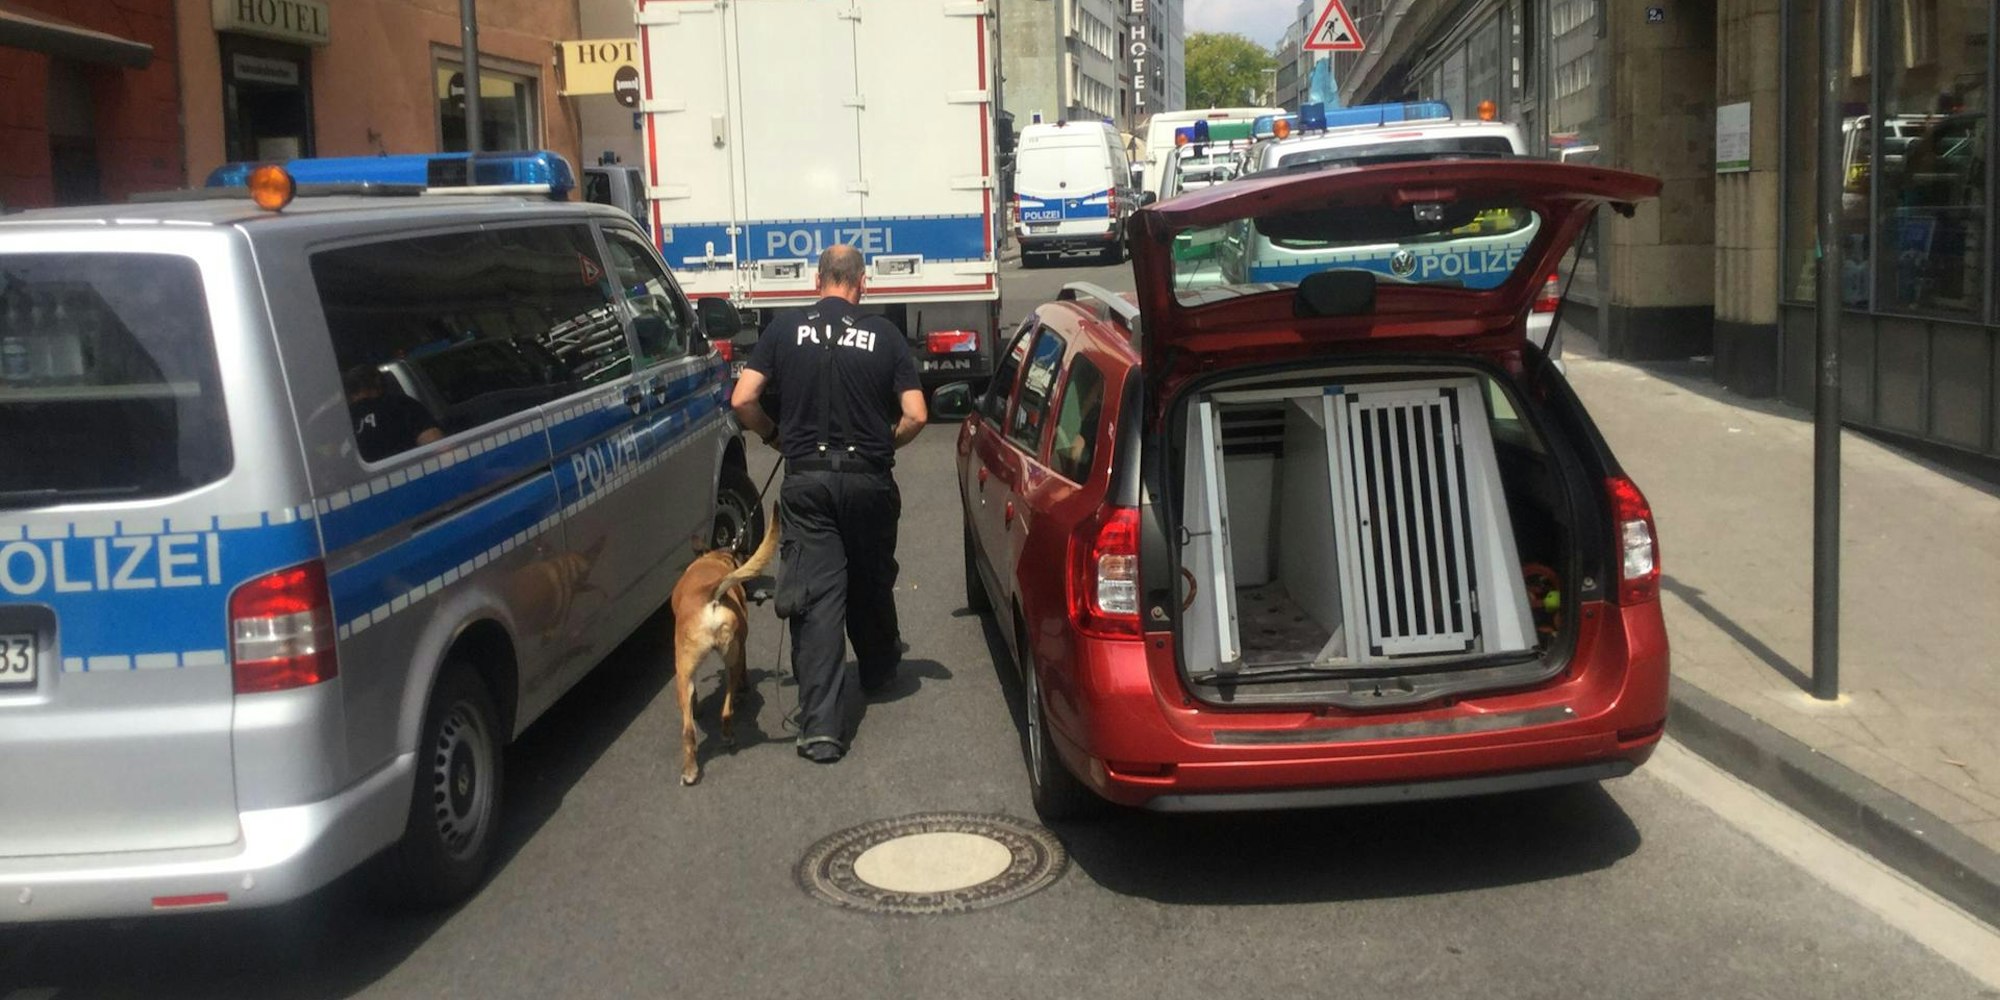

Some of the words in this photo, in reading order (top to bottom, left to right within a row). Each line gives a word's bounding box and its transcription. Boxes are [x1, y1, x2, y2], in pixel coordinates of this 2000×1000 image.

[238, 0, 327, 37] HOTEL
[578, 42, 638, 63] HOT
[1130, 25, 1147, 106] HOTEL
[1024, 210, 1060, 220] POLIZEI
[767, 227, 893, 257] POLIZEI
[923, 358, 970, 370] MAN
[571, 424, 641, 498] POLIZEI
